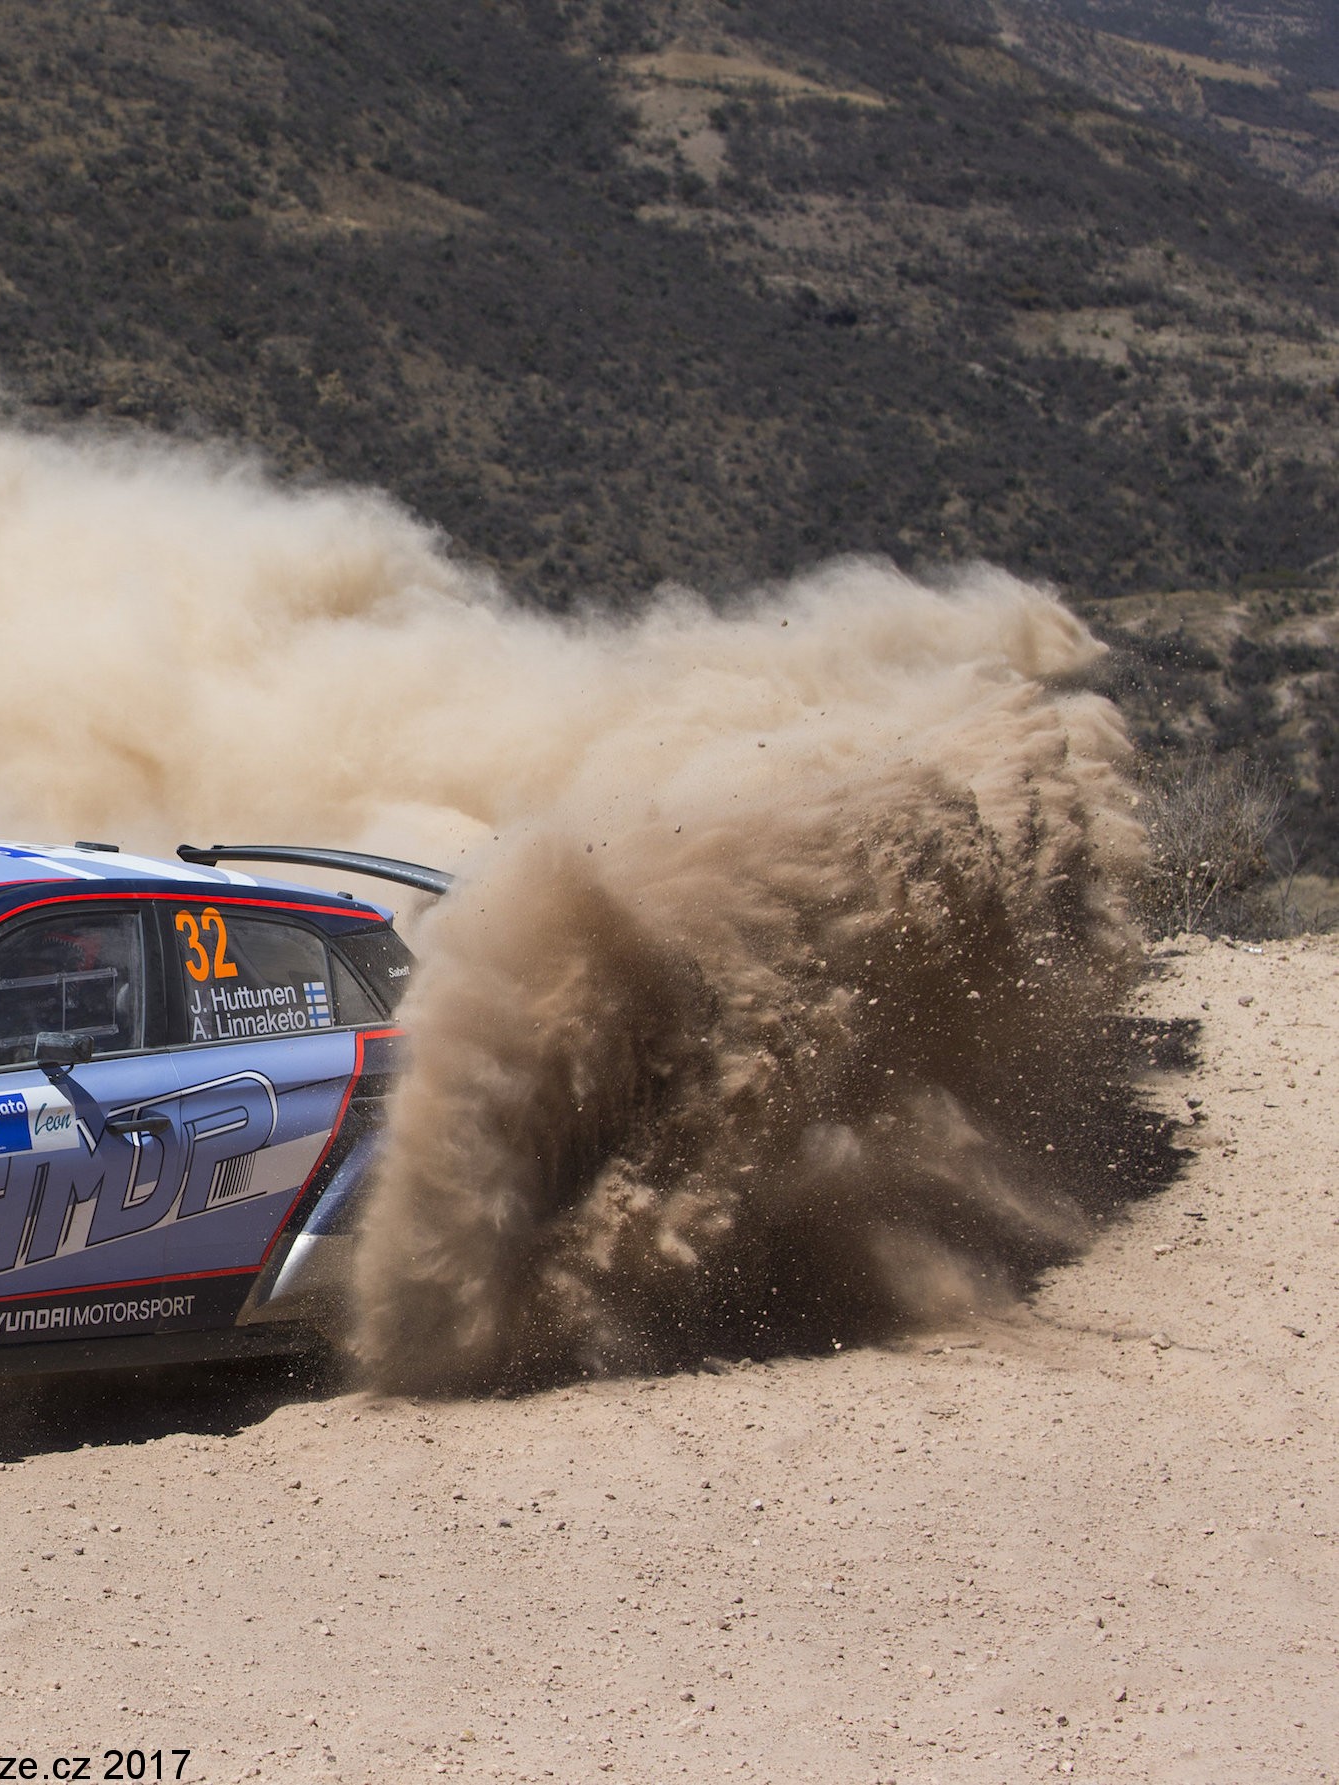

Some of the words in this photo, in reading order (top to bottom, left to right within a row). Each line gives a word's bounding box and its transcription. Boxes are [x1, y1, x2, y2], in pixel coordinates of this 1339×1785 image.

[174, 906, 238, 982] 32
[190, 990, 207, 1014] J.
[211, 985, 297, 1012] Huttunen
[192, 1017, 211, 1041] A.
[214, 1009, 307, 1038] Linnaketo
[73, 1295, 196, 1326] MOTORSPORT
